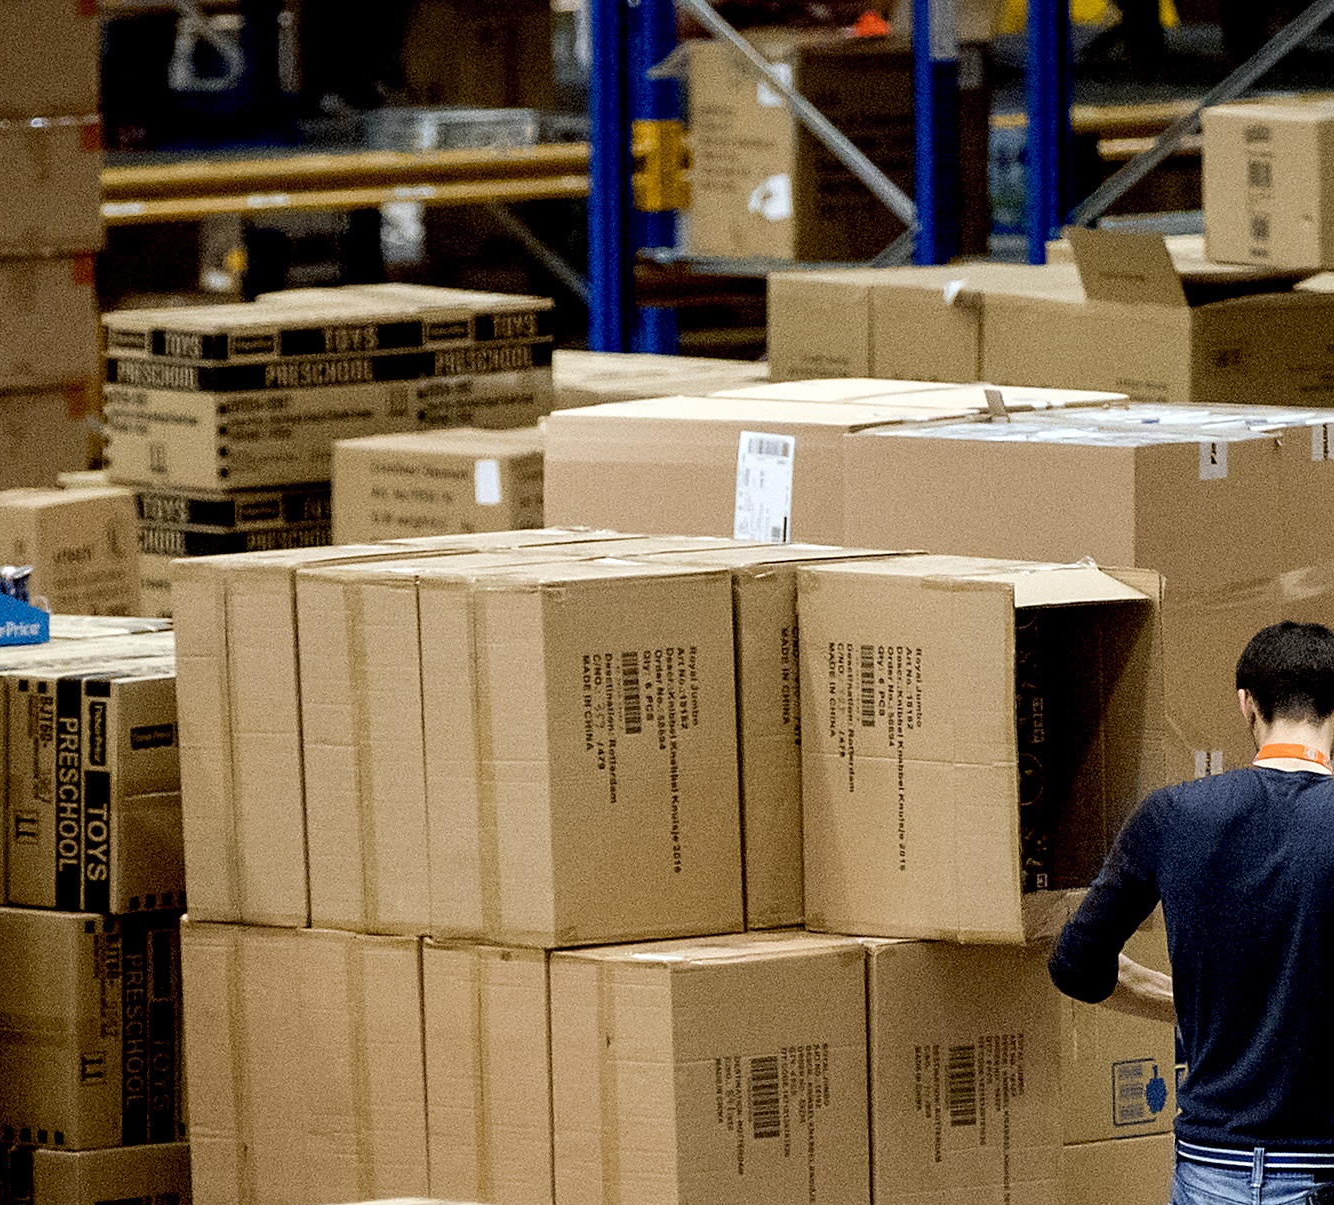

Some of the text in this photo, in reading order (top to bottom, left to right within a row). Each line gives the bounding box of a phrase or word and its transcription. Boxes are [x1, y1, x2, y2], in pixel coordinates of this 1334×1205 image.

[582, 655, 594, 752] MADE IN CHINA
[654, 649, 664, 684] Order
[780, 627, 791, 725] MADE IN CHINA
[829, 642, 837, 738] MADE IN CHINA
[887, 646, 895, 681] Order
[915, 647, 924, 728] Royal Jumbo
[59, 716, 79, 873] PRESCHOOL
[608, 739, 619, 804] Rotterdam
[848, 729, 857, 793] Rotterdam
[86, 803, 108, 880] TOYS
[126, 953, 145, 1101] PRESCHOOL
